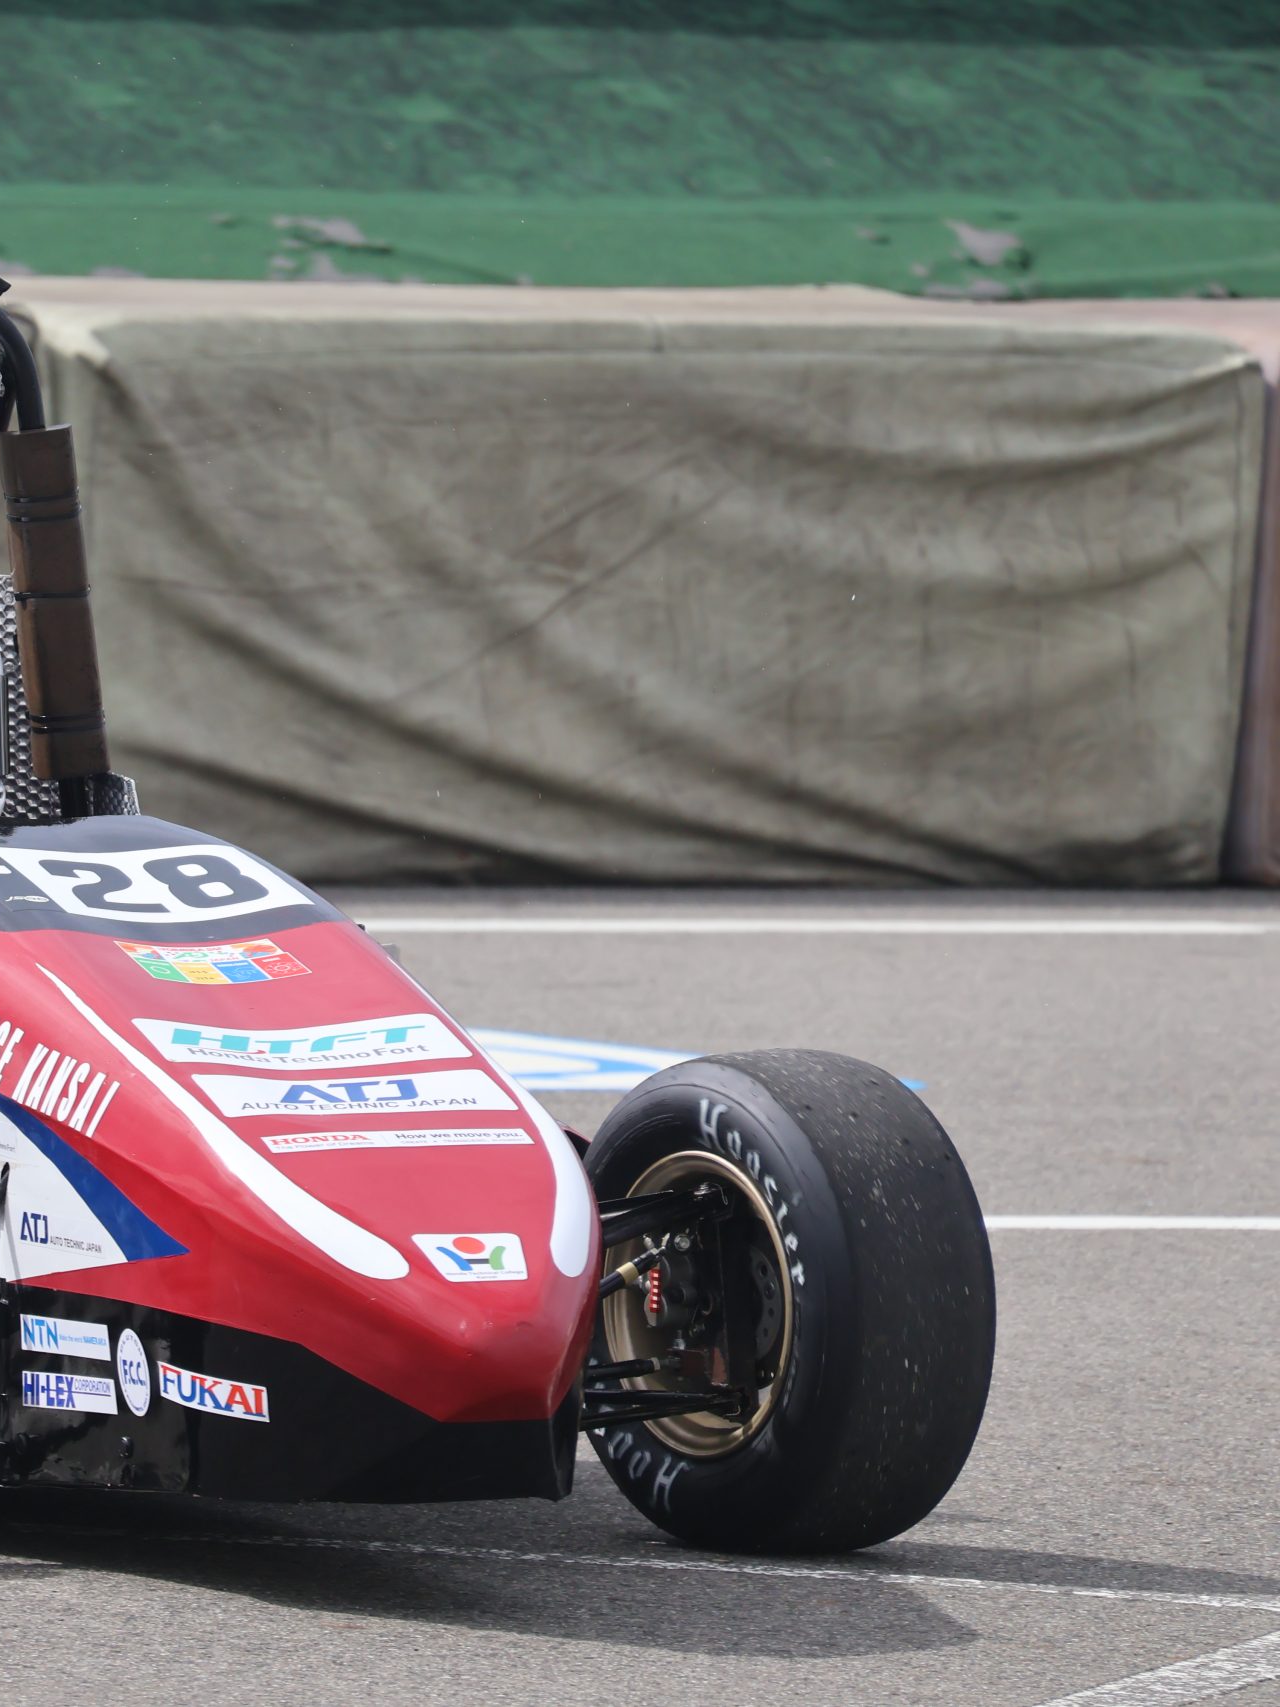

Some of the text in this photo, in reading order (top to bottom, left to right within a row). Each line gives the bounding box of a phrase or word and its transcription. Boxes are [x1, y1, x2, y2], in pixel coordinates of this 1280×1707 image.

[38, 854, 270, 913] 28
[171, 1025, 426, 1055] HTFT
[11, 1042, 121, 1139] KANSAI
[241, 1097, 478, 1111] AUTO TECHNIC JAPAN
[279, 1079, 419, 1105] ATJ
[270, 1134, 370, 1146] HONDA
[20, 1211, 49, 1245] ATJ
[22, 1315, 60, 1350] NTN
[24, 1372, 111, 1408] HI-LEX CORPORATION
[160, 1364, 266, 1418] FUKAI
